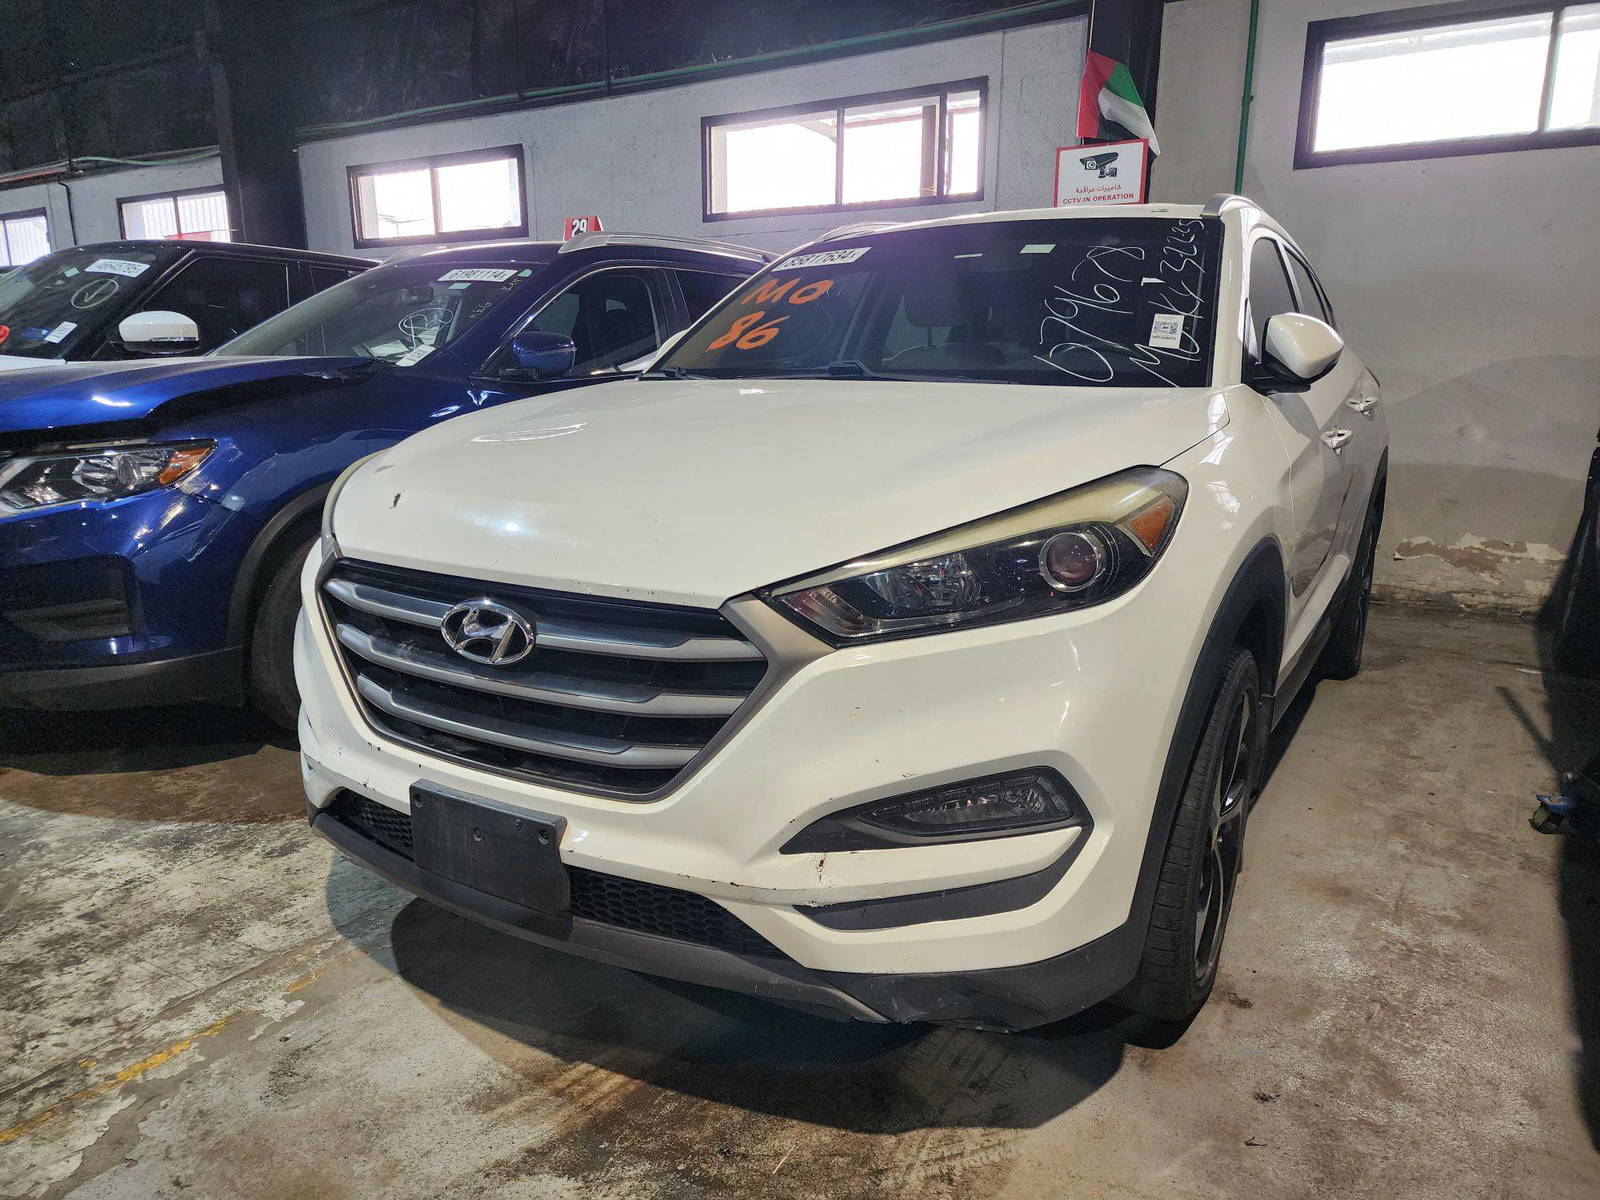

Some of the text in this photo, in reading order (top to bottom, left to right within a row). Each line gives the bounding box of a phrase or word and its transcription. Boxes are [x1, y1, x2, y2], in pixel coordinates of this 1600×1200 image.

[1062, 197, 1082, 205] CCTV
[1092, 192, 1135, 202] OPERATION
[741, 277, 834, 305] MO
[705, 310, 791, 353] 86
